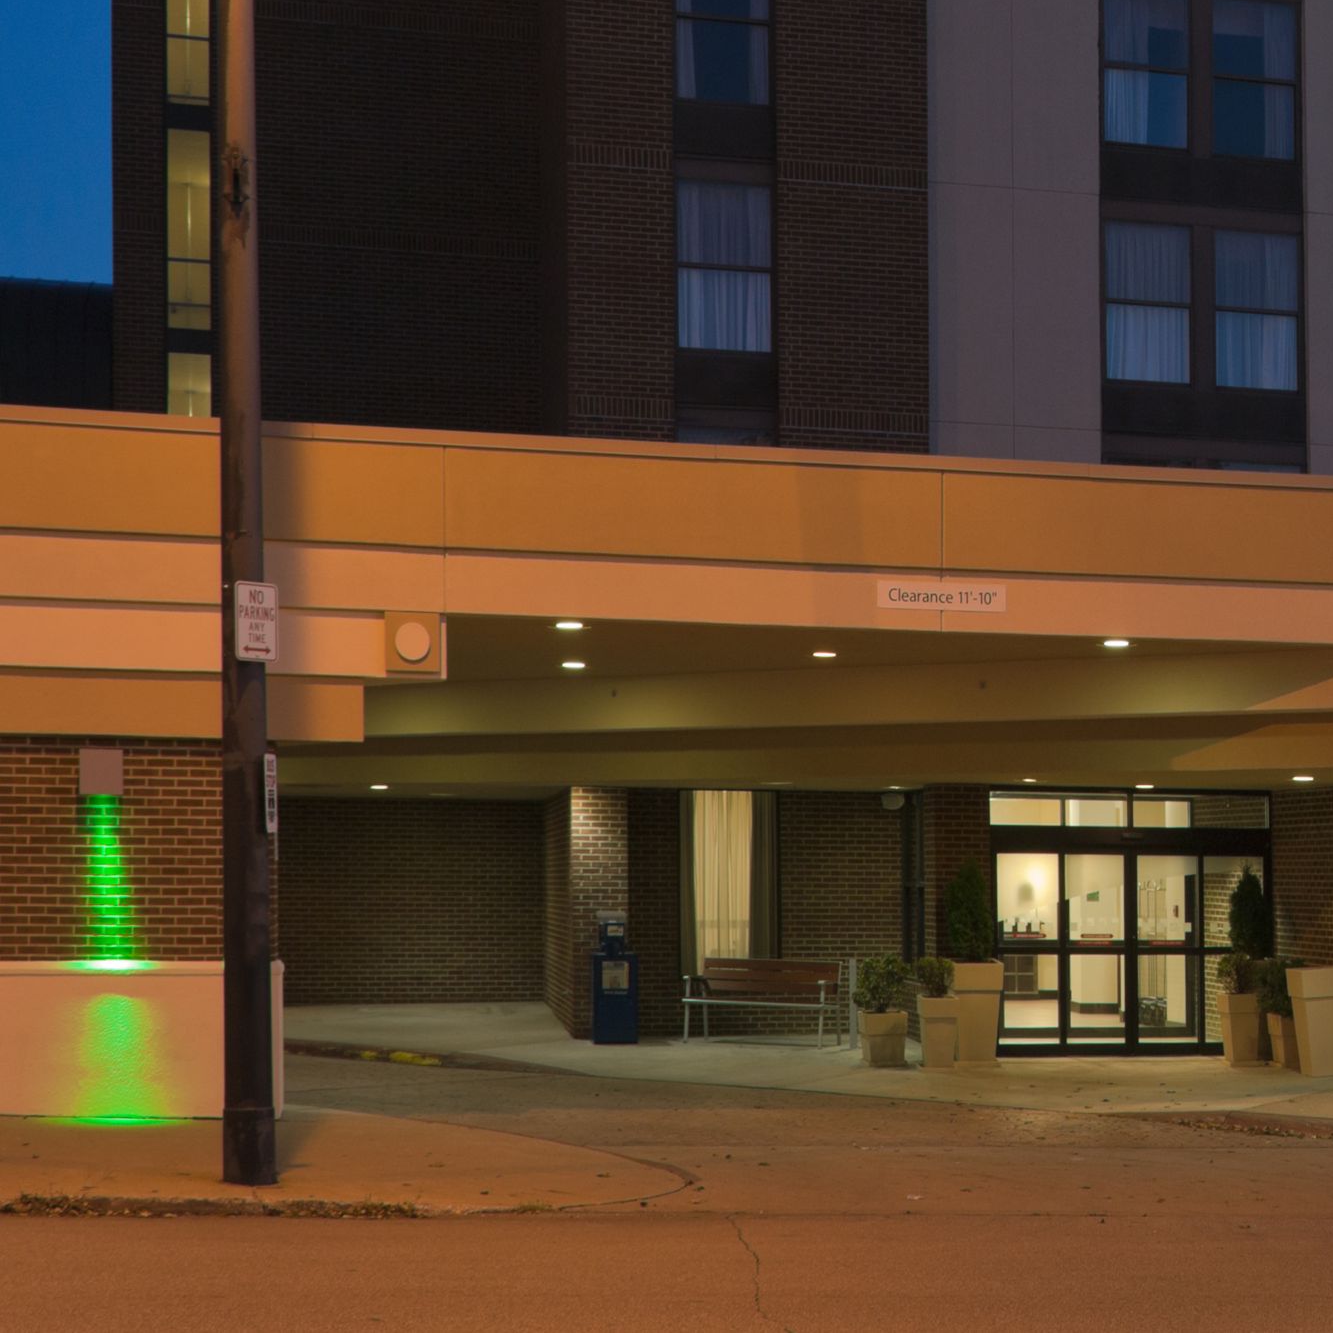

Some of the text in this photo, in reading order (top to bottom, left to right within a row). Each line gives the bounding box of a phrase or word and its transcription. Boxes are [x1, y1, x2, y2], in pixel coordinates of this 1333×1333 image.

[249, 589, 264, 604] NO
[888, 587, 997, 605] Clearance 11'-10"
[239, 605, 275, 622] PARKING
[248, 622, 265, 632] ANY
[248, 633, 266, 644] TIME
